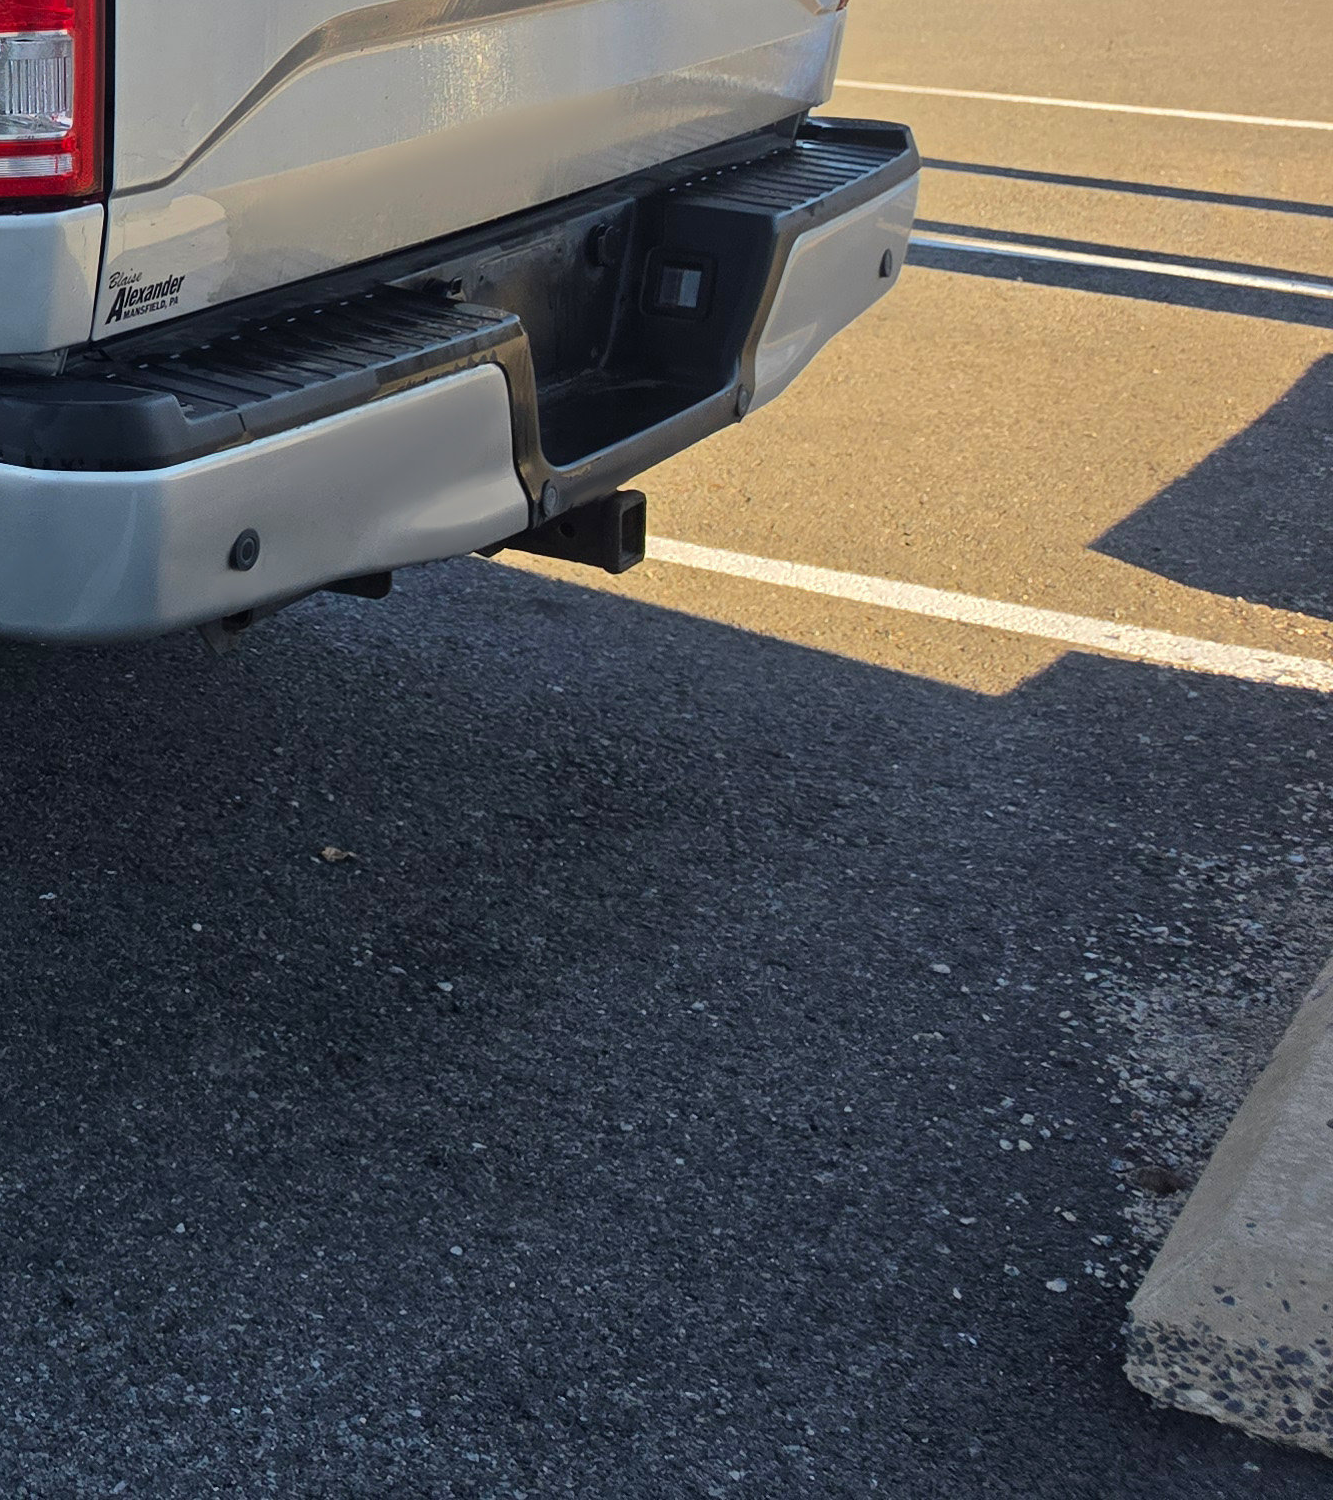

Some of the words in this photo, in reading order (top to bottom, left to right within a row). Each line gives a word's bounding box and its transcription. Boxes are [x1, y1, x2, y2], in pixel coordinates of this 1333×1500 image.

[108, 267, 143, 290] Blaise
[104, 274, 186, 326] Alexander
[122, 300, 168, 320] MANSFIELD,
[169, 296, 179, 307] PA
